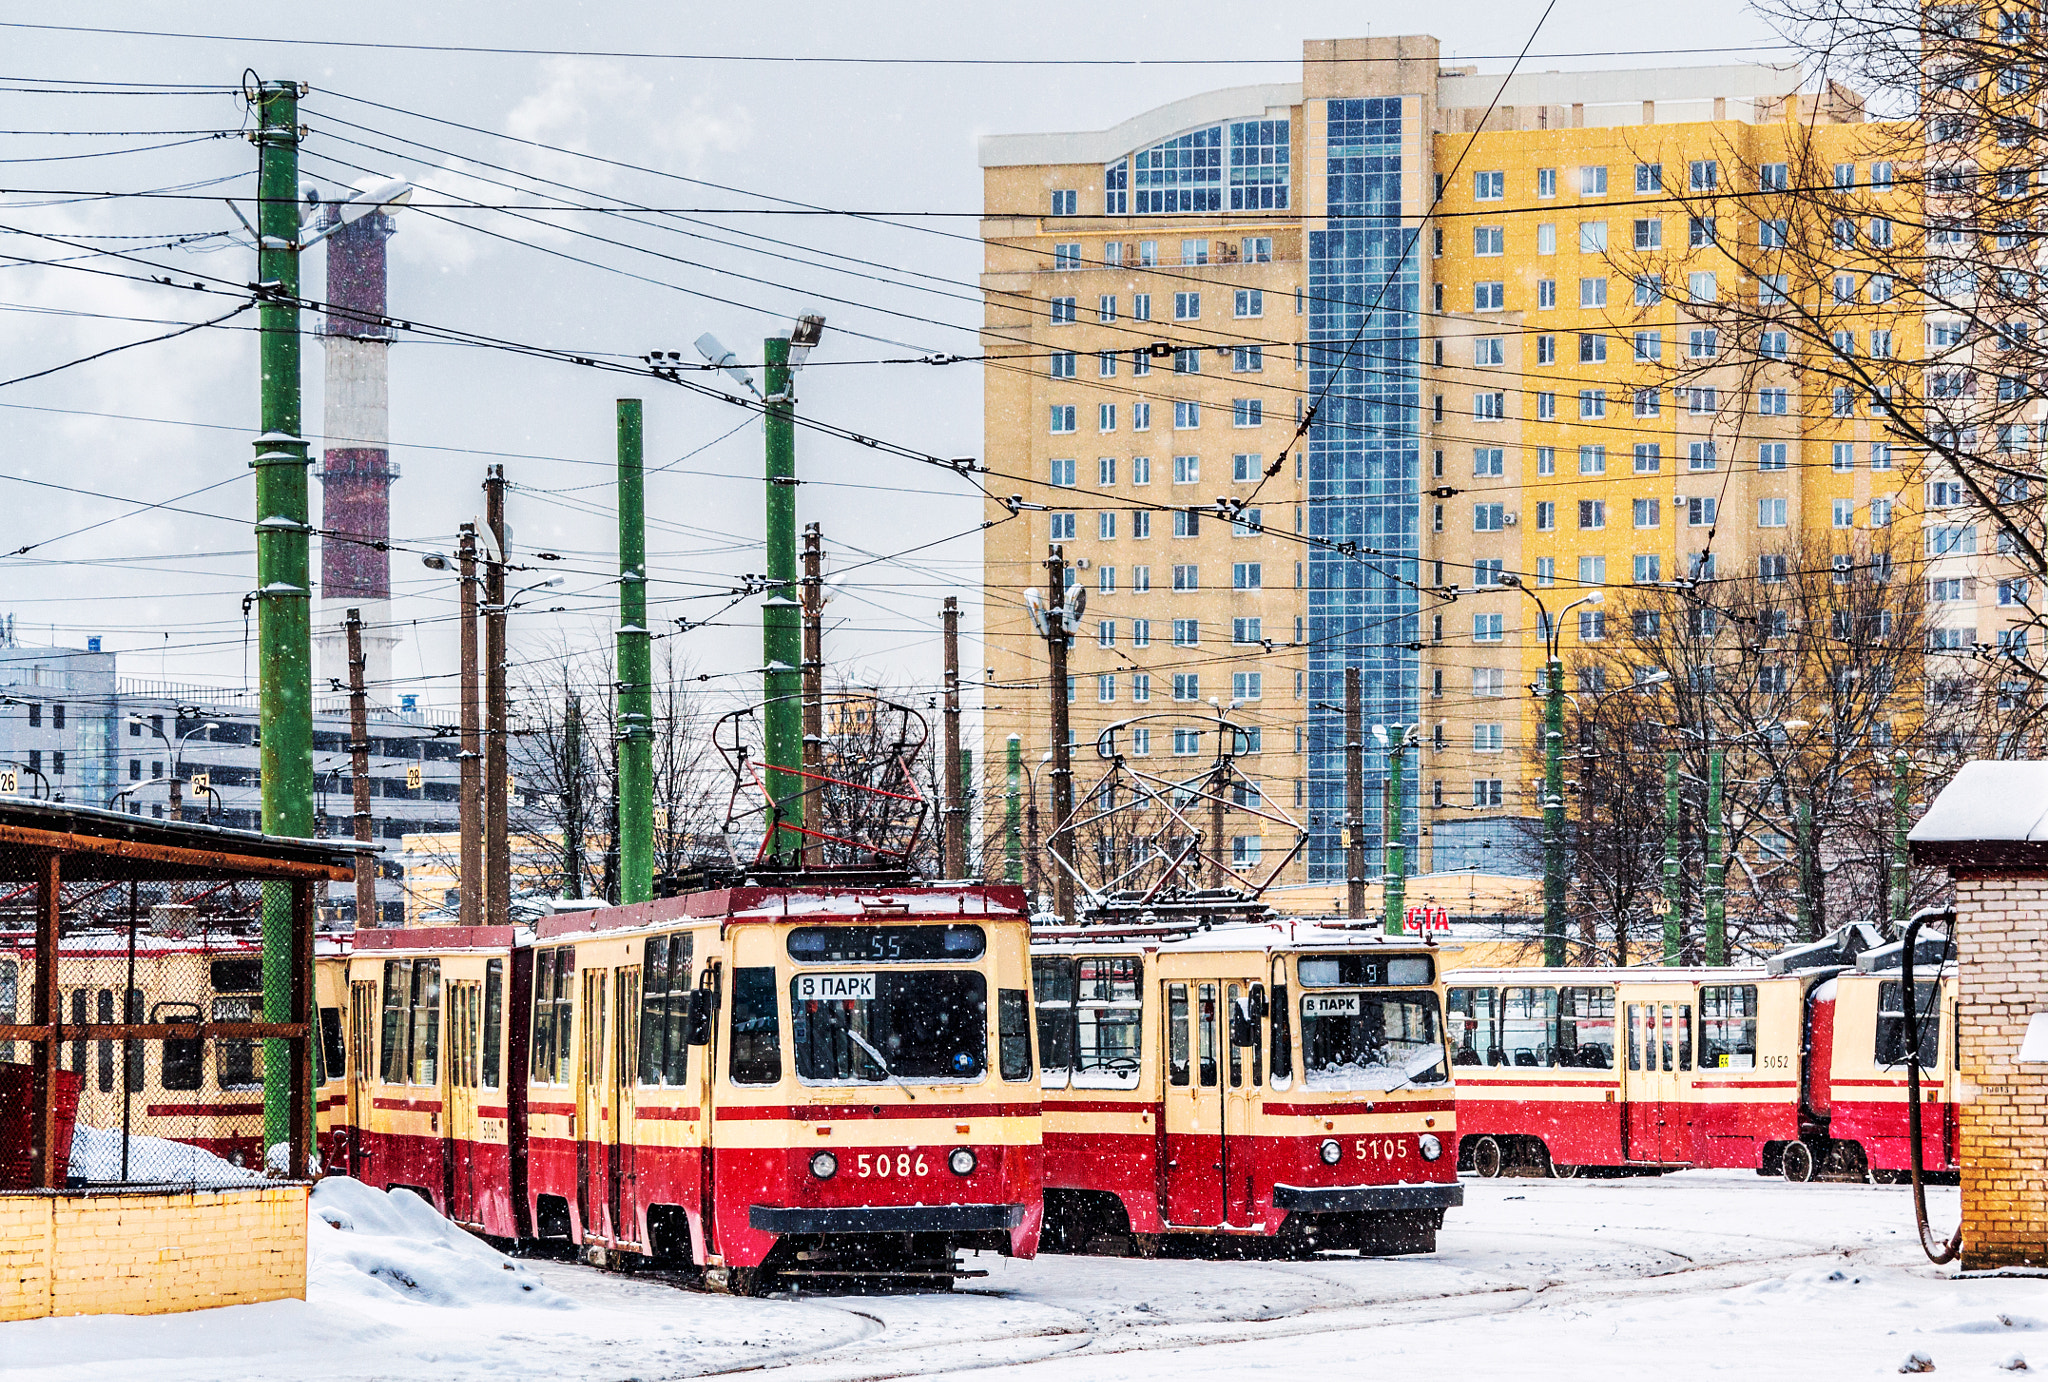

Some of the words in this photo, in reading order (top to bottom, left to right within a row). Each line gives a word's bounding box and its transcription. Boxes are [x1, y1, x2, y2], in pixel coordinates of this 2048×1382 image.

[1, 773, 15, 791] 26
[408, 768, 420, 787] 28
[656, 811, 667, 827] 30
[872, 935, 900, 958] 55
[1366, 964, 1377, 982] 9
[803, 978, 815, 996] В
[821, 977, 872, 996] ПАРК
[1306, 1000, 1315, 1011] В
[1319, 998, 1355, 1011] ПАРК
[1764, 1055, 1789, 1069] 5052
[1355, 1139, 1407, 1160] 5105
[858, 1153, 929, 1178] 5086
